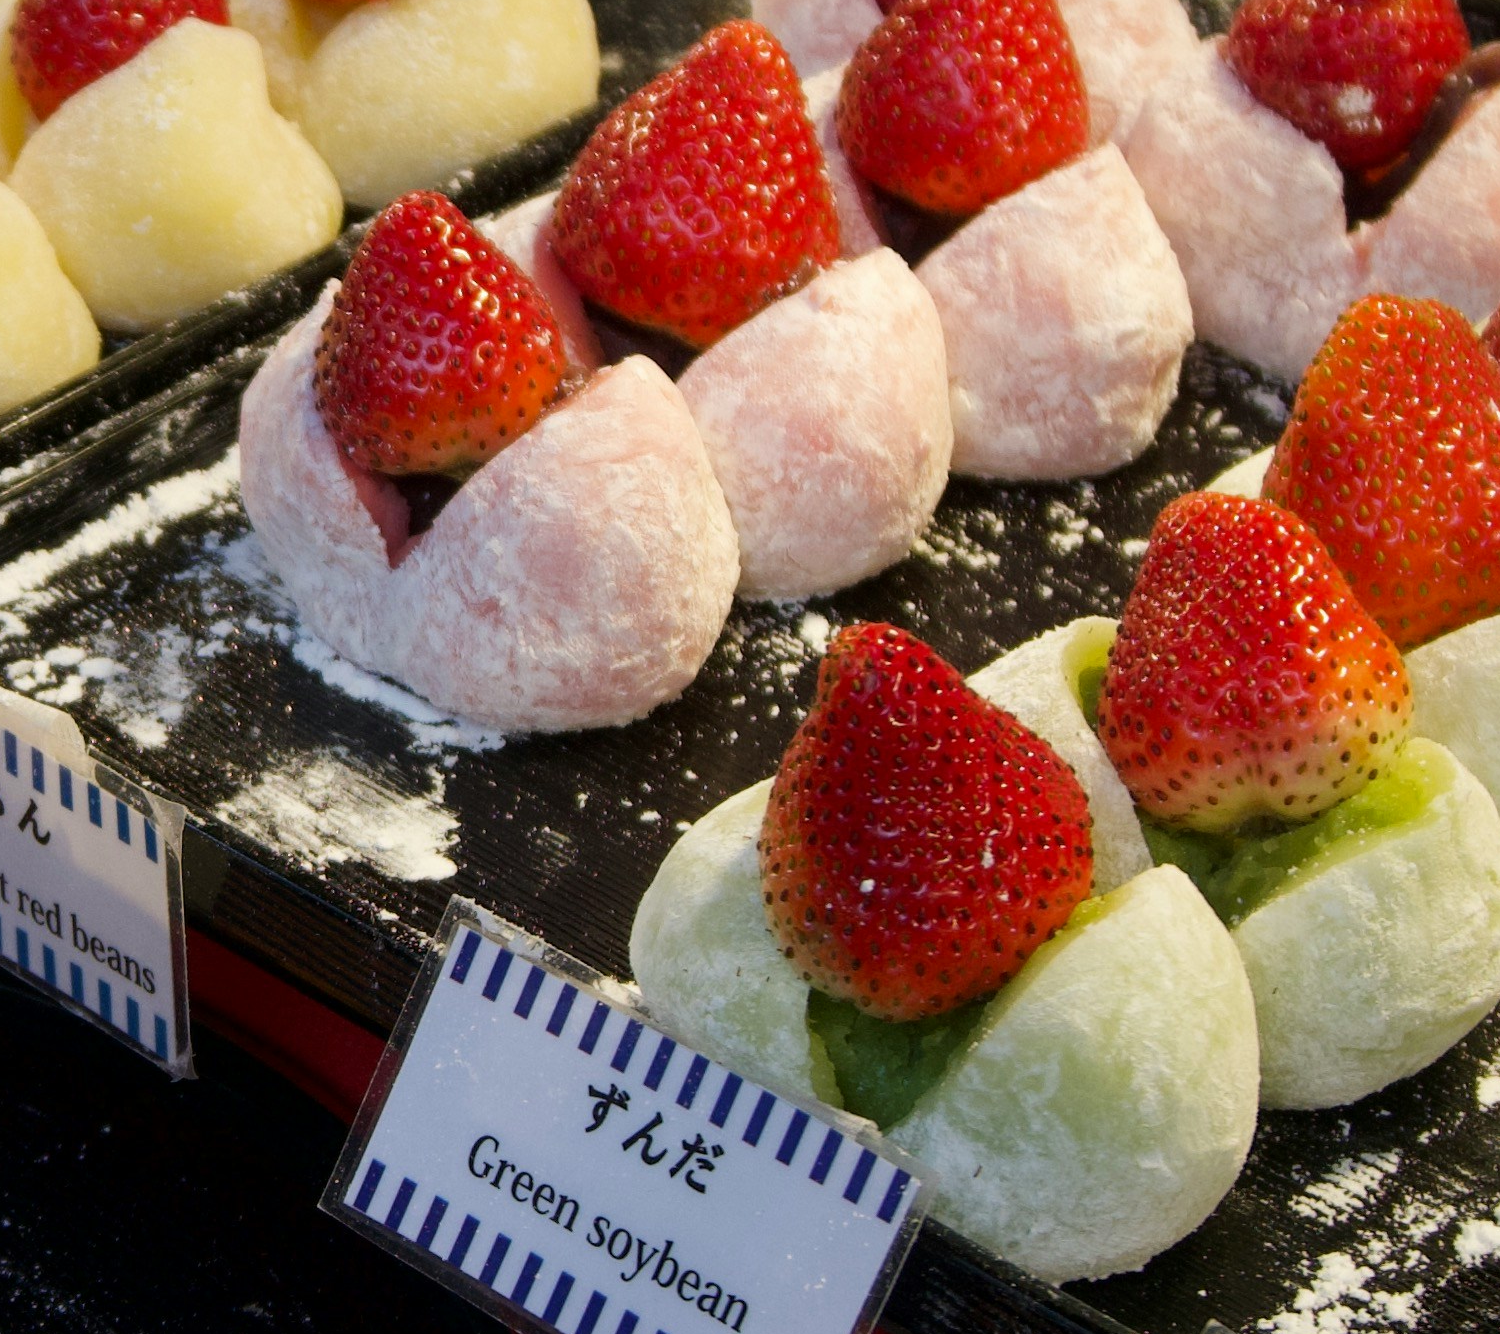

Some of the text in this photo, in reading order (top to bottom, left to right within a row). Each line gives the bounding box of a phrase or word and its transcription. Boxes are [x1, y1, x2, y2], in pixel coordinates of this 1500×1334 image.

[17, 887, 63, 940] red
[71, 913, 157, 995] beans
[585, 1082, 725, 1195] ずんだ
[467, 1134, 750, 1334] Green soybean
